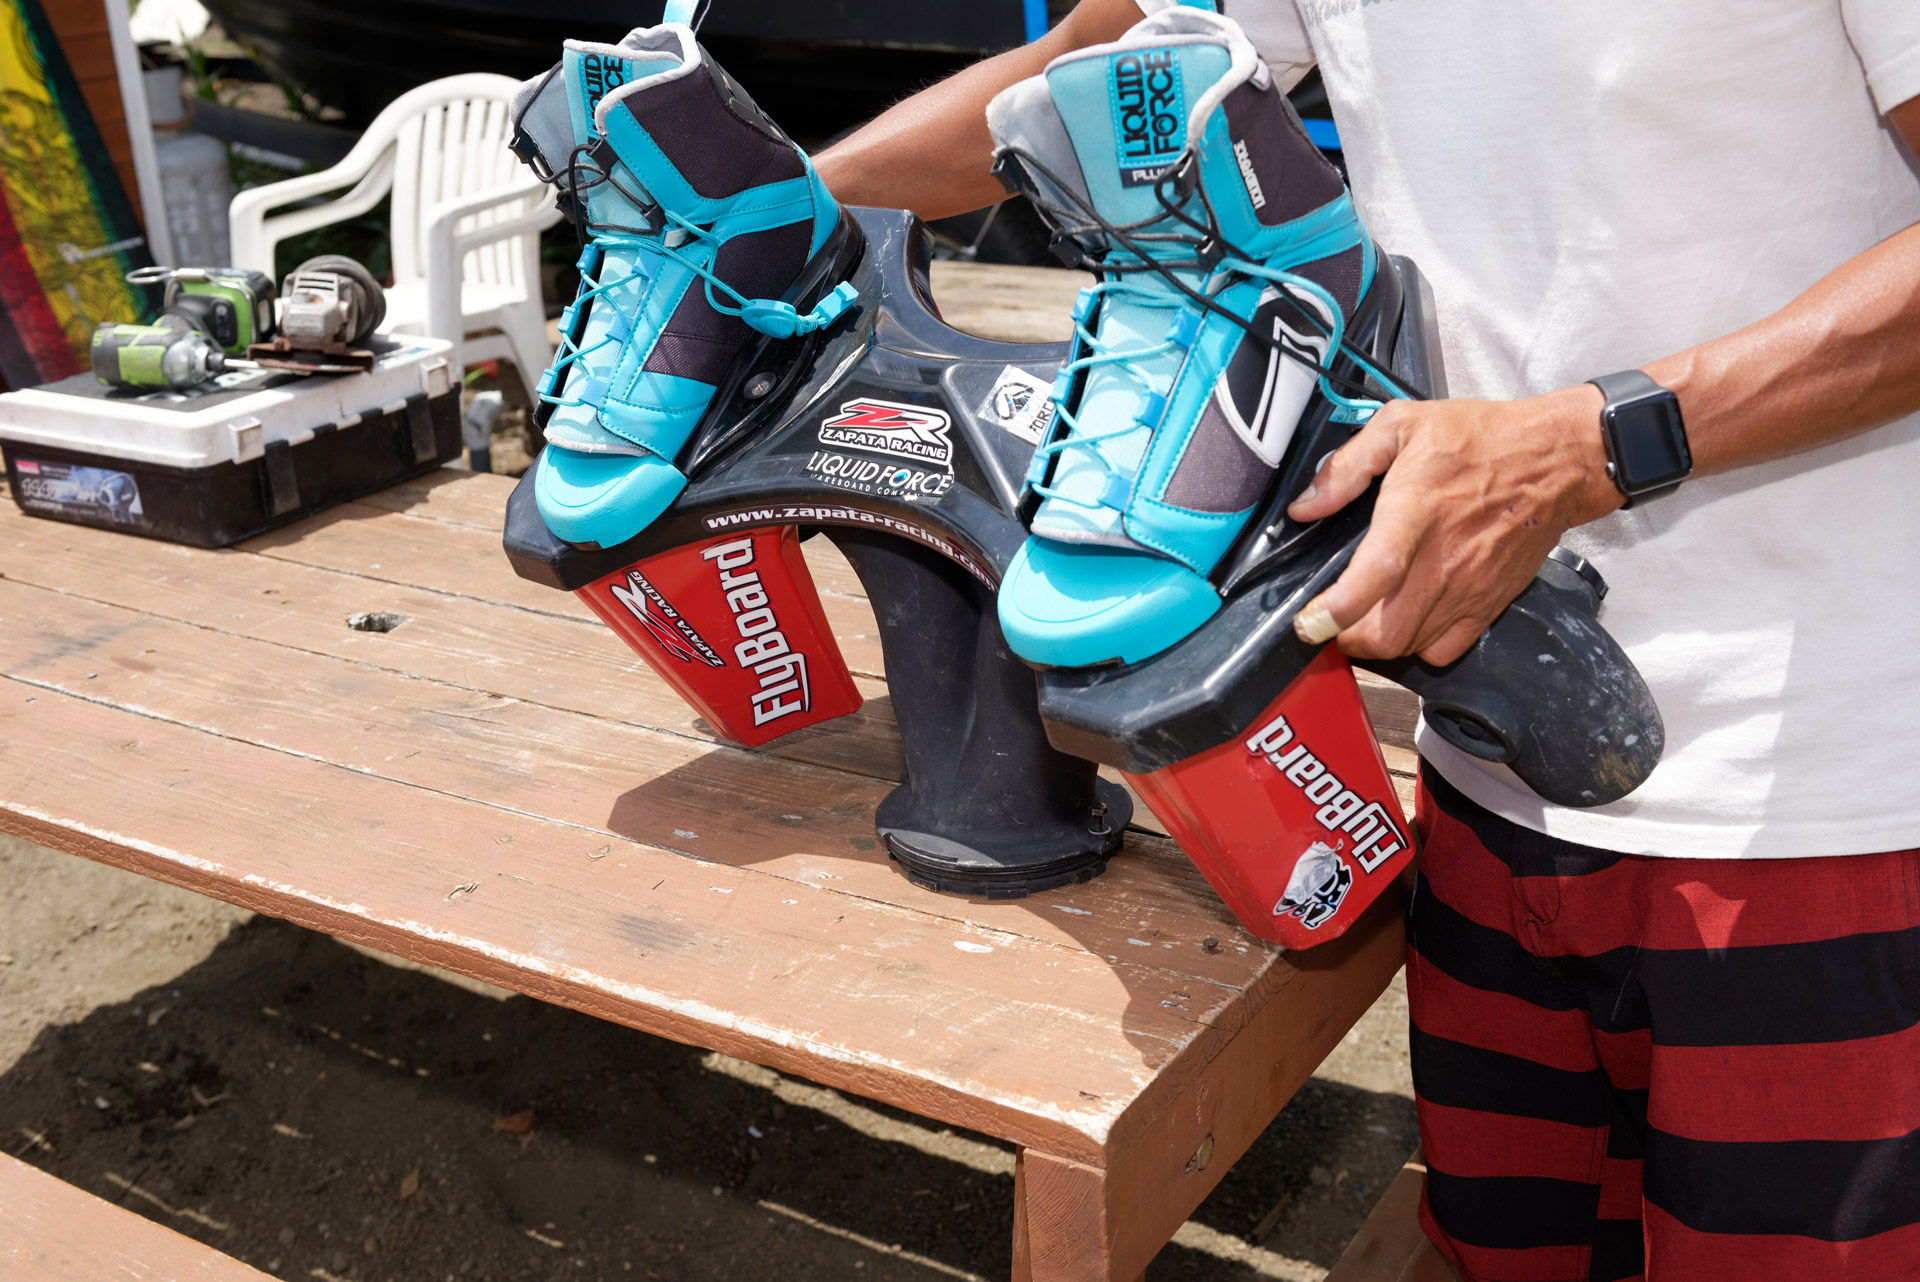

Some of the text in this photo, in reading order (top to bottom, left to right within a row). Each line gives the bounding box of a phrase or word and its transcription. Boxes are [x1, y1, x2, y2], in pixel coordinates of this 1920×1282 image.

[1116, 55, 1151, 158] LIQUID
[1144, 51, 1181, 155] FORCE
[823, 428, 947, 460] ZAPATA RACING
[1029, 396, 1055, 435] FORC
[806, 451, 954, 495] LIQUID FORCE
[629, 571, 725, 667] ZAPATA RACING
